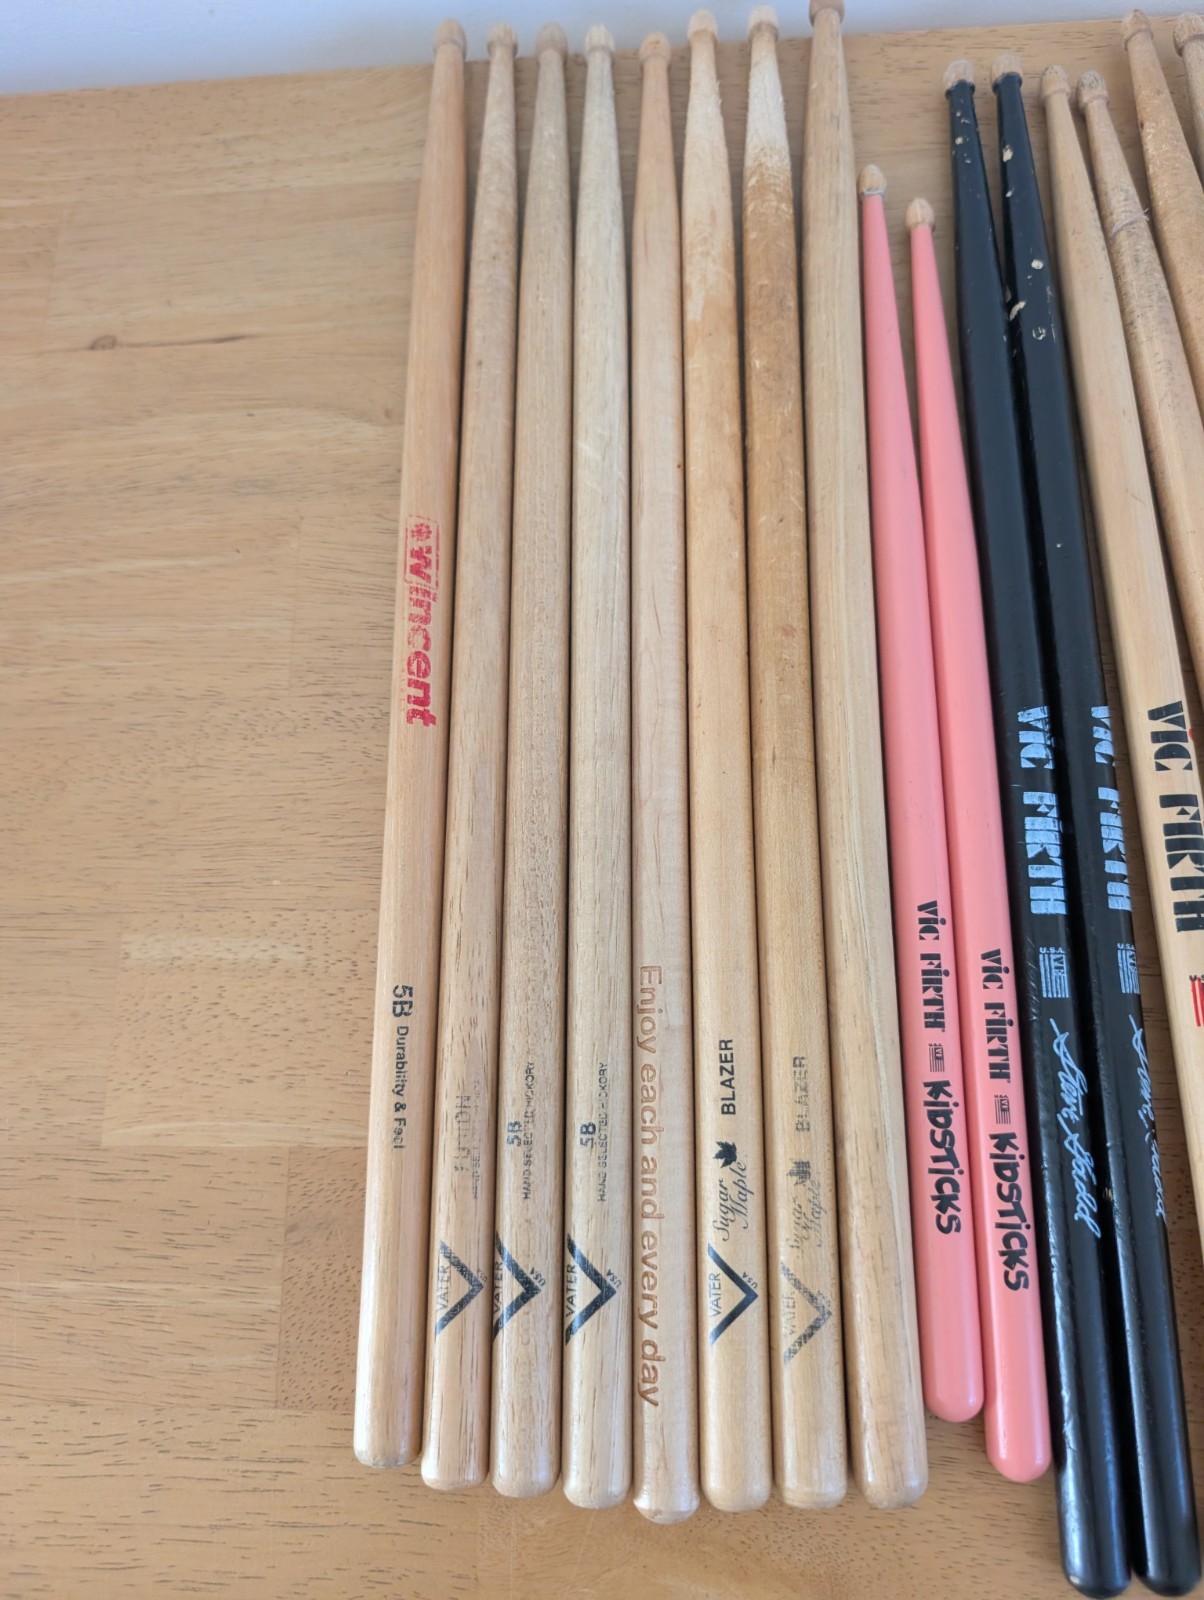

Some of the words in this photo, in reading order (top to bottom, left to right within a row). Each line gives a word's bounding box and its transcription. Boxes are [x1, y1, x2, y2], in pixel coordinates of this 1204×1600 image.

[392, 984, 414, 1018] 5B
[636, 964, 663, 1054] Enjoy
[391, 1025, 410, 1098] Durability
[718, 1039, 736, 1116] BLAZER
[393, 1101, 407, 1113] &
[579, 1121, 596, 1149] 5B
[639, 1062, 665, 1144] each
[639, 1156, 665, 1221] and
[712, 1177, 735, 1242] Sugar
[729, 1160, 755, 1230] Maple
[435, 1264, 450, 1312] VATER
[565, 1263, 578, 1317] VATER
[636, 1229, 660, 1330] every
[708, 1272, 722, 1318] VATER
[741, 1271, 759, 1290] USA
[636, 1341, 666, 1408] day
